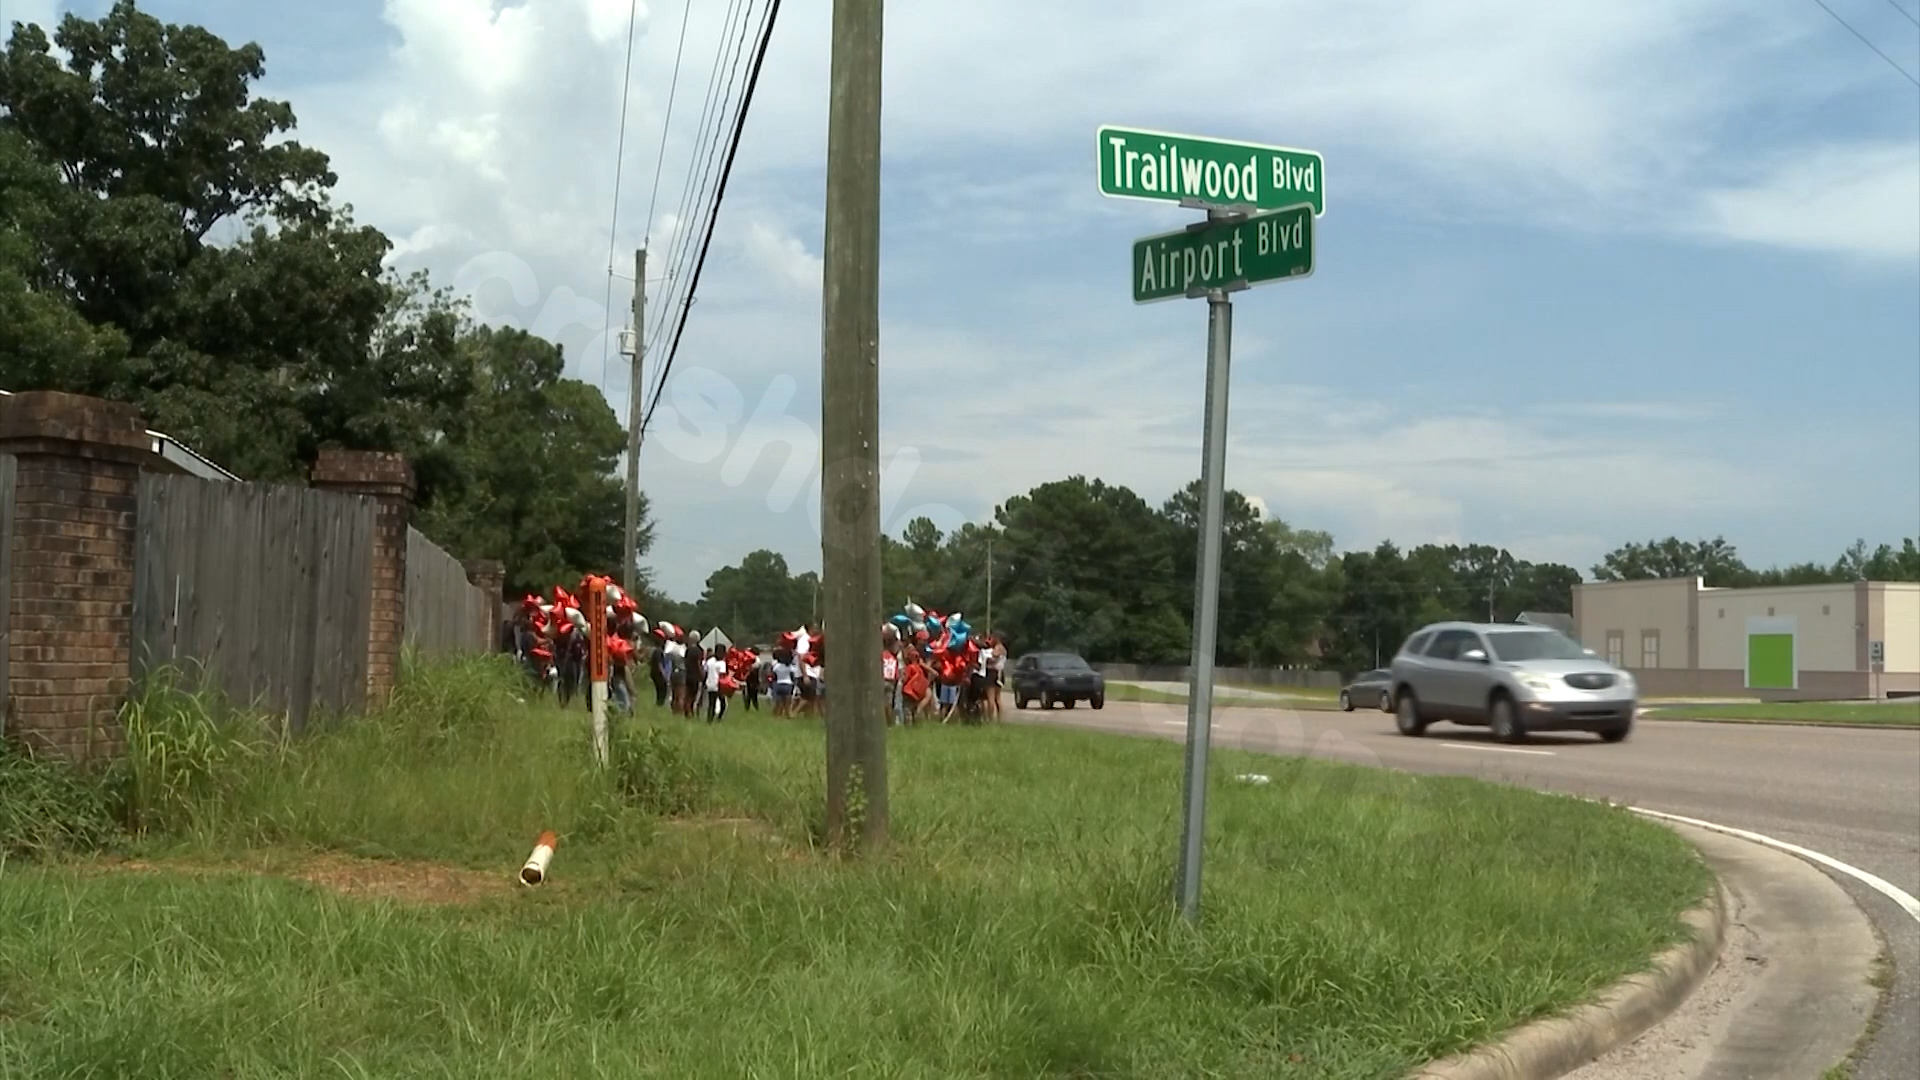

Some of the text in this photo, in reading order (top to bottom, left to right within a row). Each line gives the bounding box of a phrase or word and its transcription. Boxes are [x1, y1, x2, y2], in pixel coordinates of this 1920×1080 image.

[1109, 137, 1315, 202] Trailwood Blvd
[1141, 215, 1303, 292] Airport Blvd
